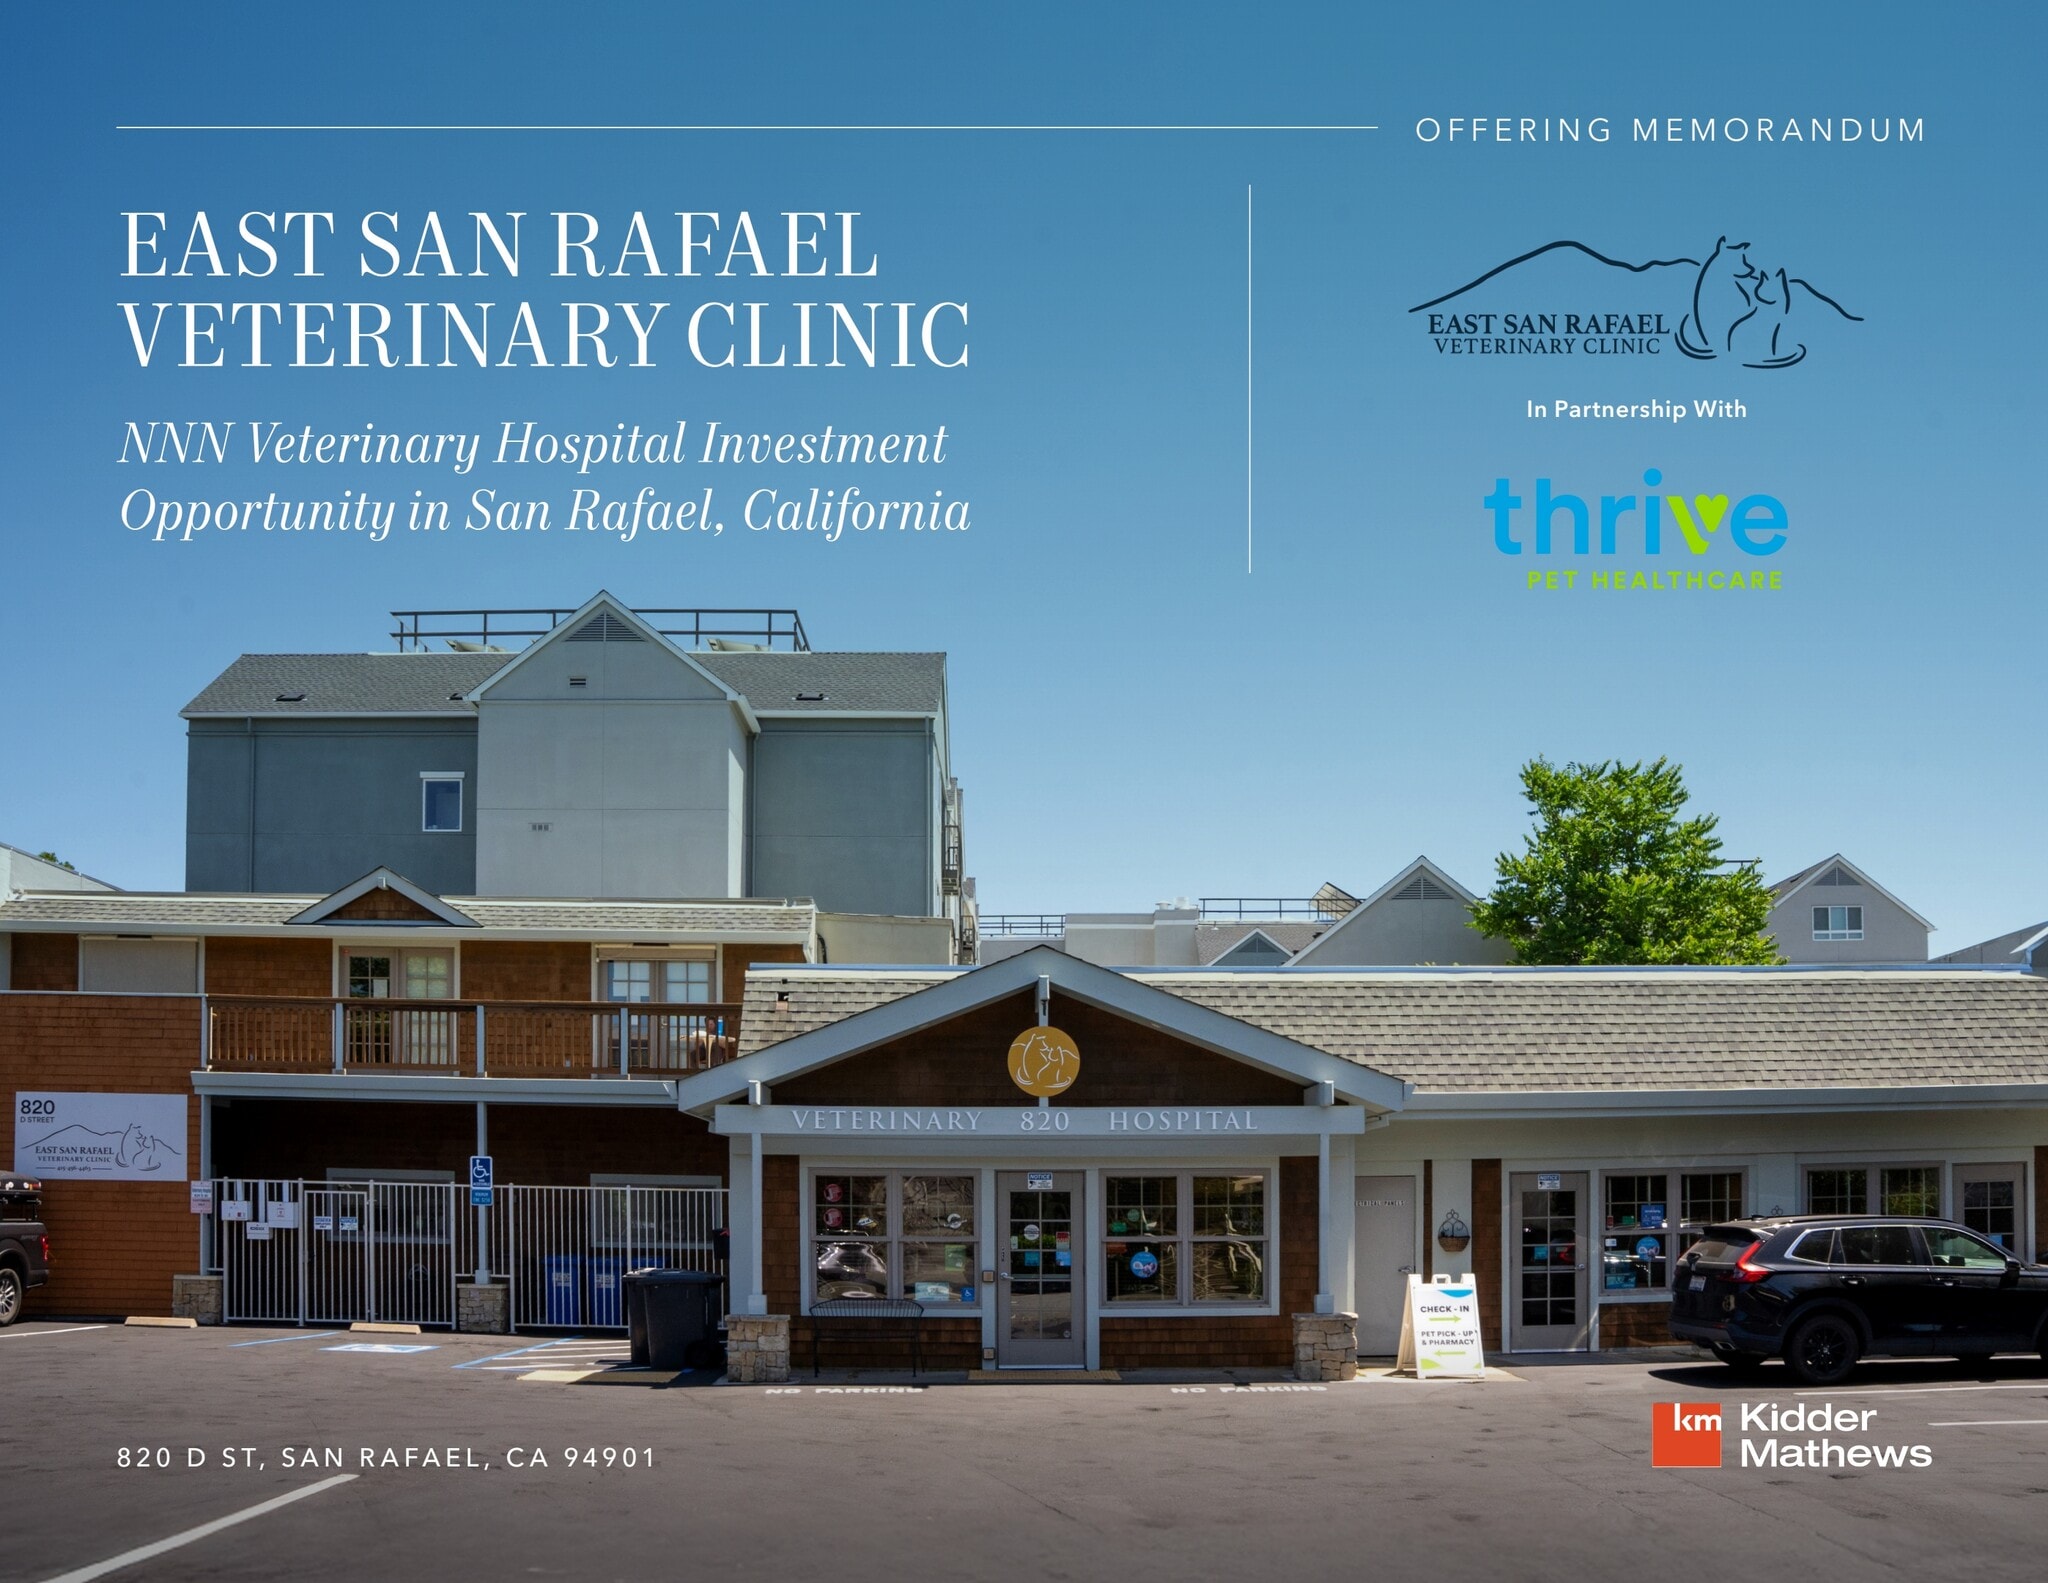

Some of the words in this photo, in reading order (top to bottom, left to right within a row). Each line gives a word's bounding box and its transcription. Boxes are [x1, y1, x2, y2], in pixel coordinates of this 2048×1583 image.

[21, 1099, 56, 1115] 820
[28, 1116, 55, 1124] STREET
[791, 1109, 983, 1131] VETERINARY
[1020, 1111, 1070, 1132] 820
[1109, 1109, 1259, 1131] HOSPITAL
[35, 1145, 58, 1154] EAST
[59, 1146, 78, 1155] SAN
[80, 1146, 114, 1155] RAFAEL
[38, 1155, 84, 1163] VETERINARY
[1420, 1305, 1452, 1313] CHECK
[1459, 1305, 1470, 1313] IN
[1219, 1385, 1328, 1393] PARKING
